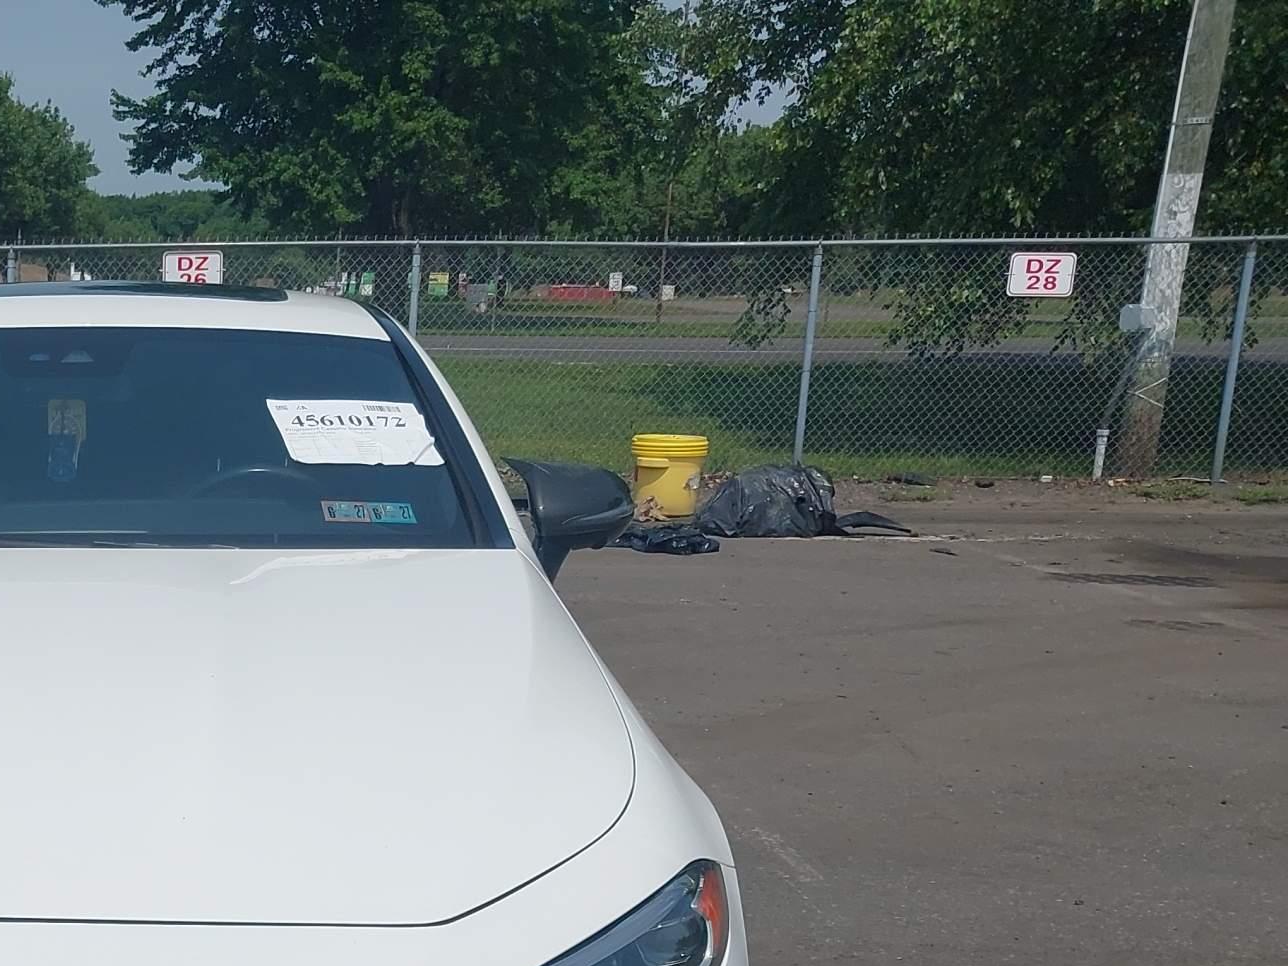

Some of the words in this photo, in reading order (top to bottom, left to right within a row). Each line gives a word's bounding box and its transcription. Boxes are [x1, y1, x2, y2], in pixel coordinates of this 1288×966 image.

[177, 256, 209, 272] DZ
[1025, 258, 1062, 274] DZ
[1026, 275, 1057, 291] 28
[291, 414, 407, 429] 45610172
